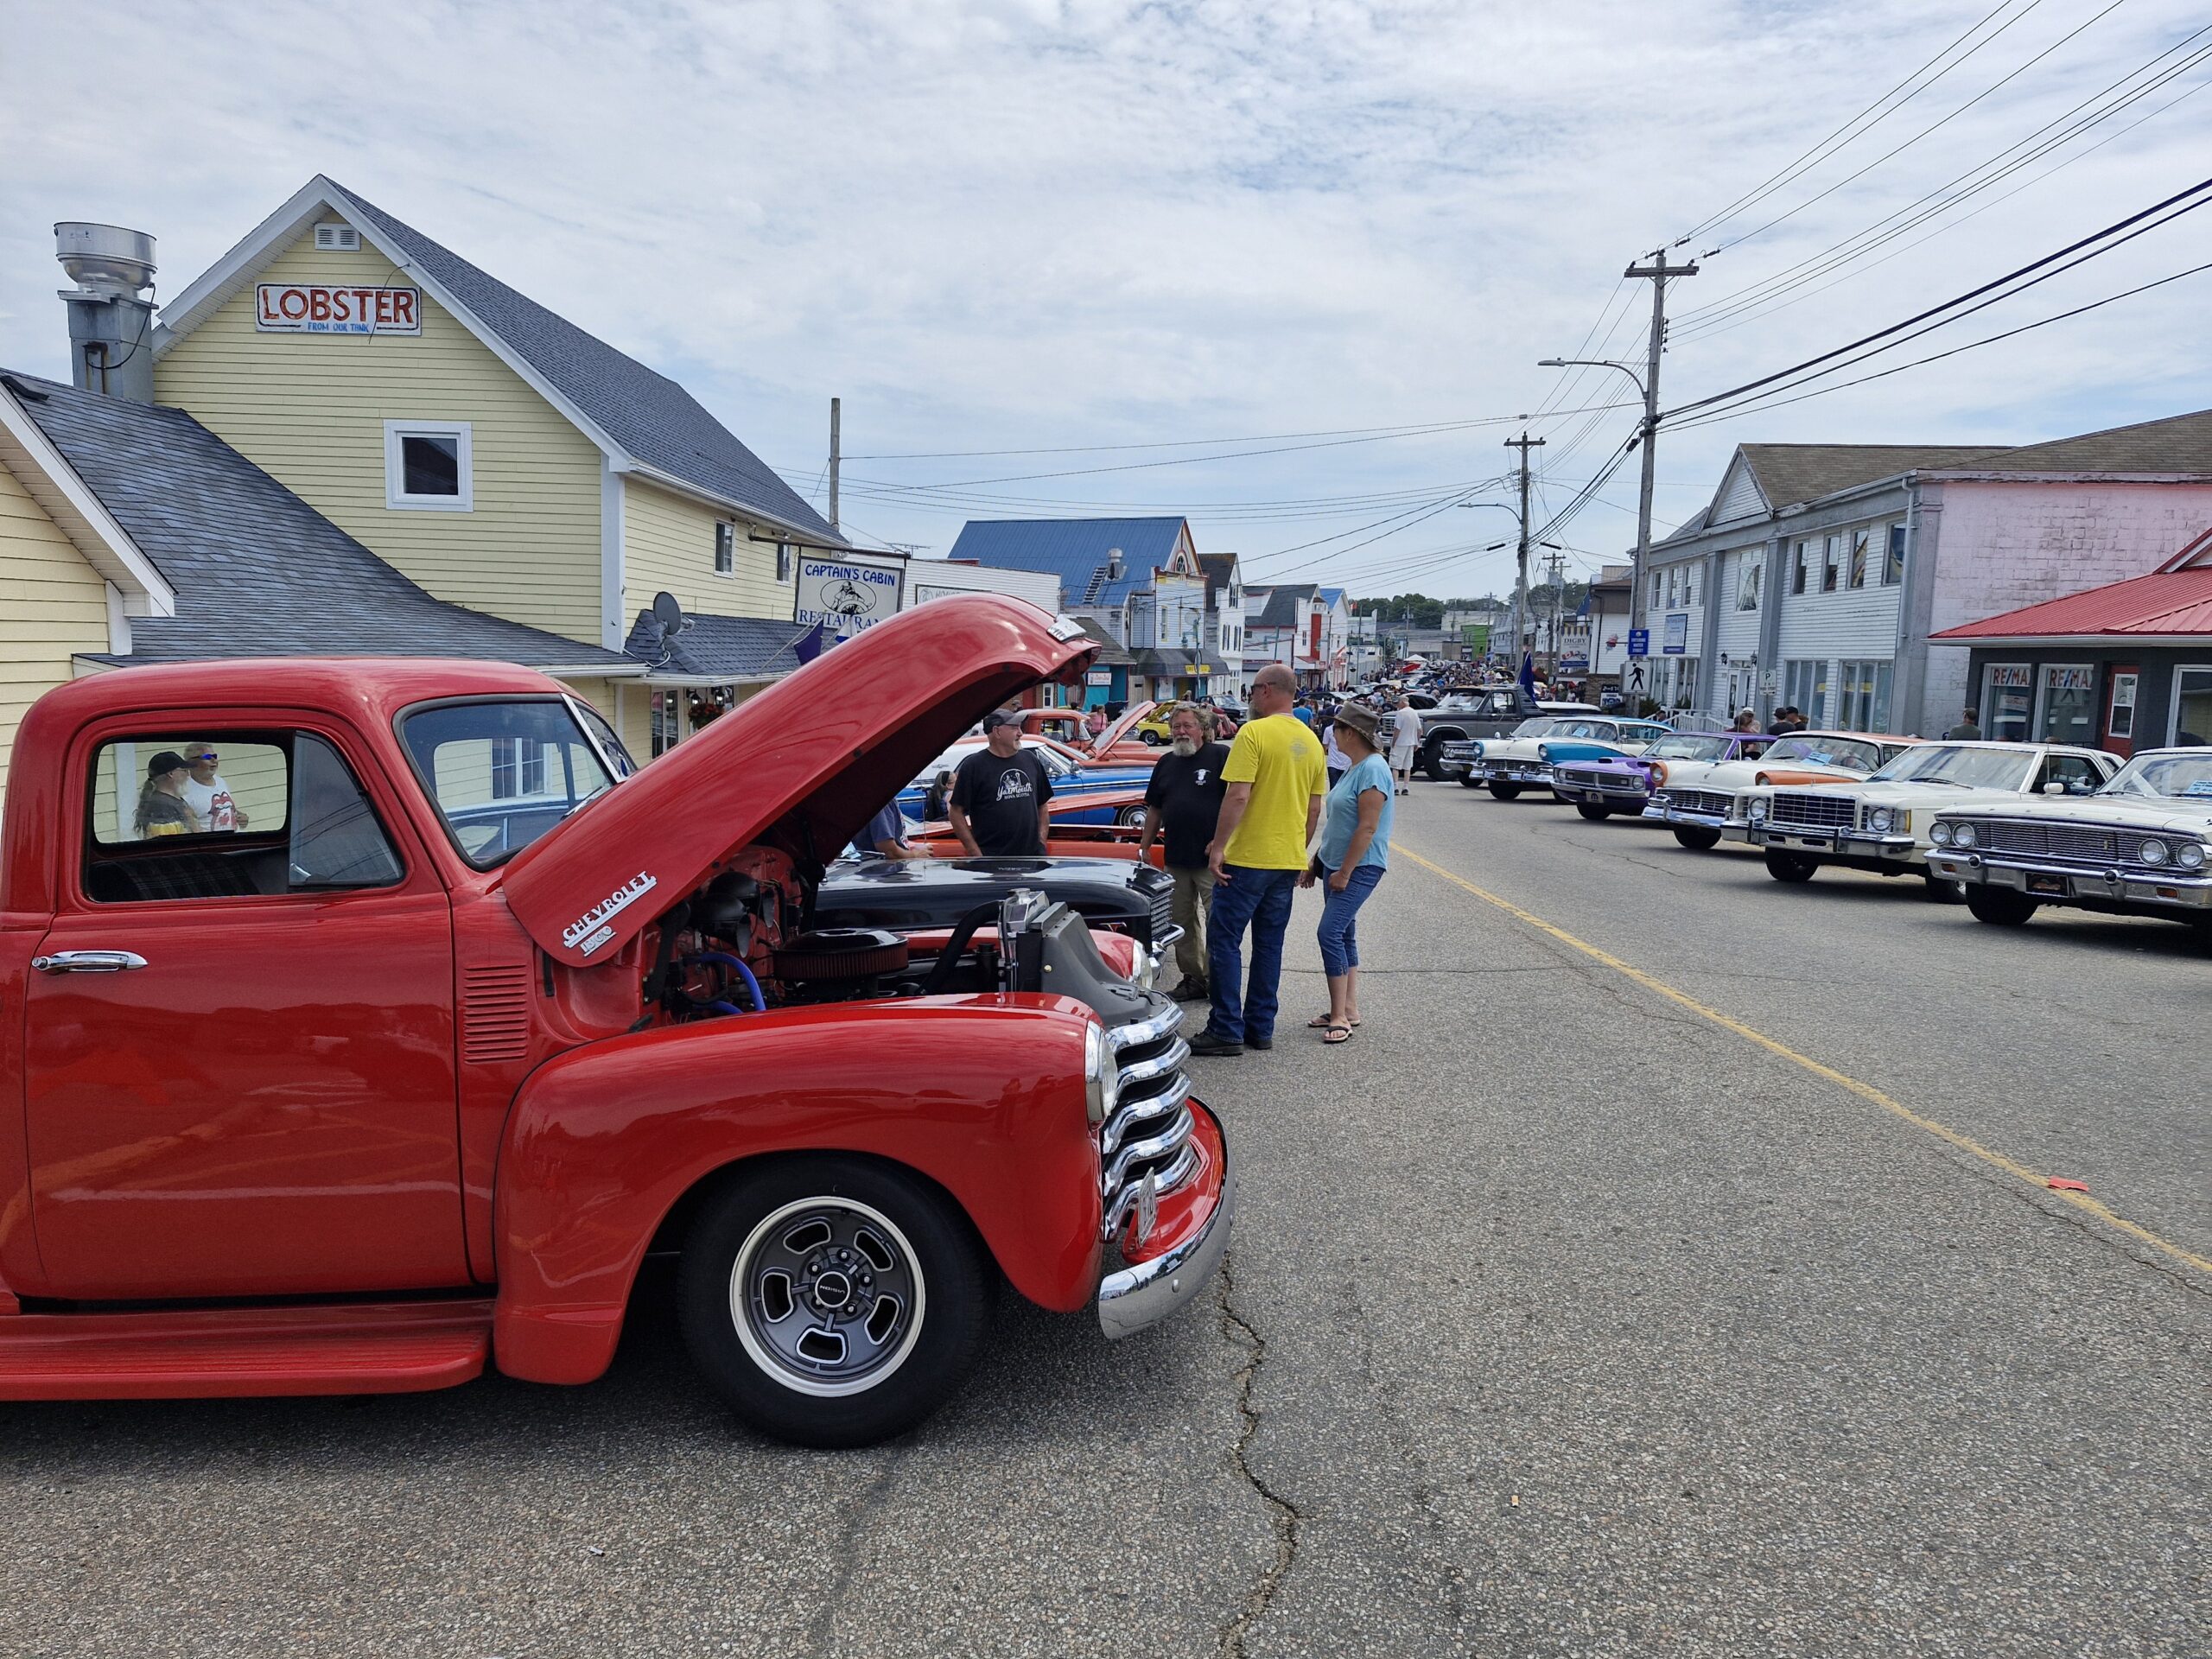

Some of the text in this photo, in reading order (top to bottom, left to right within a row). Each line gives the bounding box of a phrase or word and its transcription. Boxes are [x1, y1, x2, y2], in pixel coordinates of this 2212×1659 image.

[263, 289, 414, 324] LOBSTER
[308, 321, 370, 333] FROM OUR TANK
[805, 564, 895, 587] CAPTAIN'S CABIN
[1993, 669, 2092, 688] RE/MA RE/MA
[563, 870, 652, 942] CHEVROLET
[820, 1285, 845, 1294] VISION
